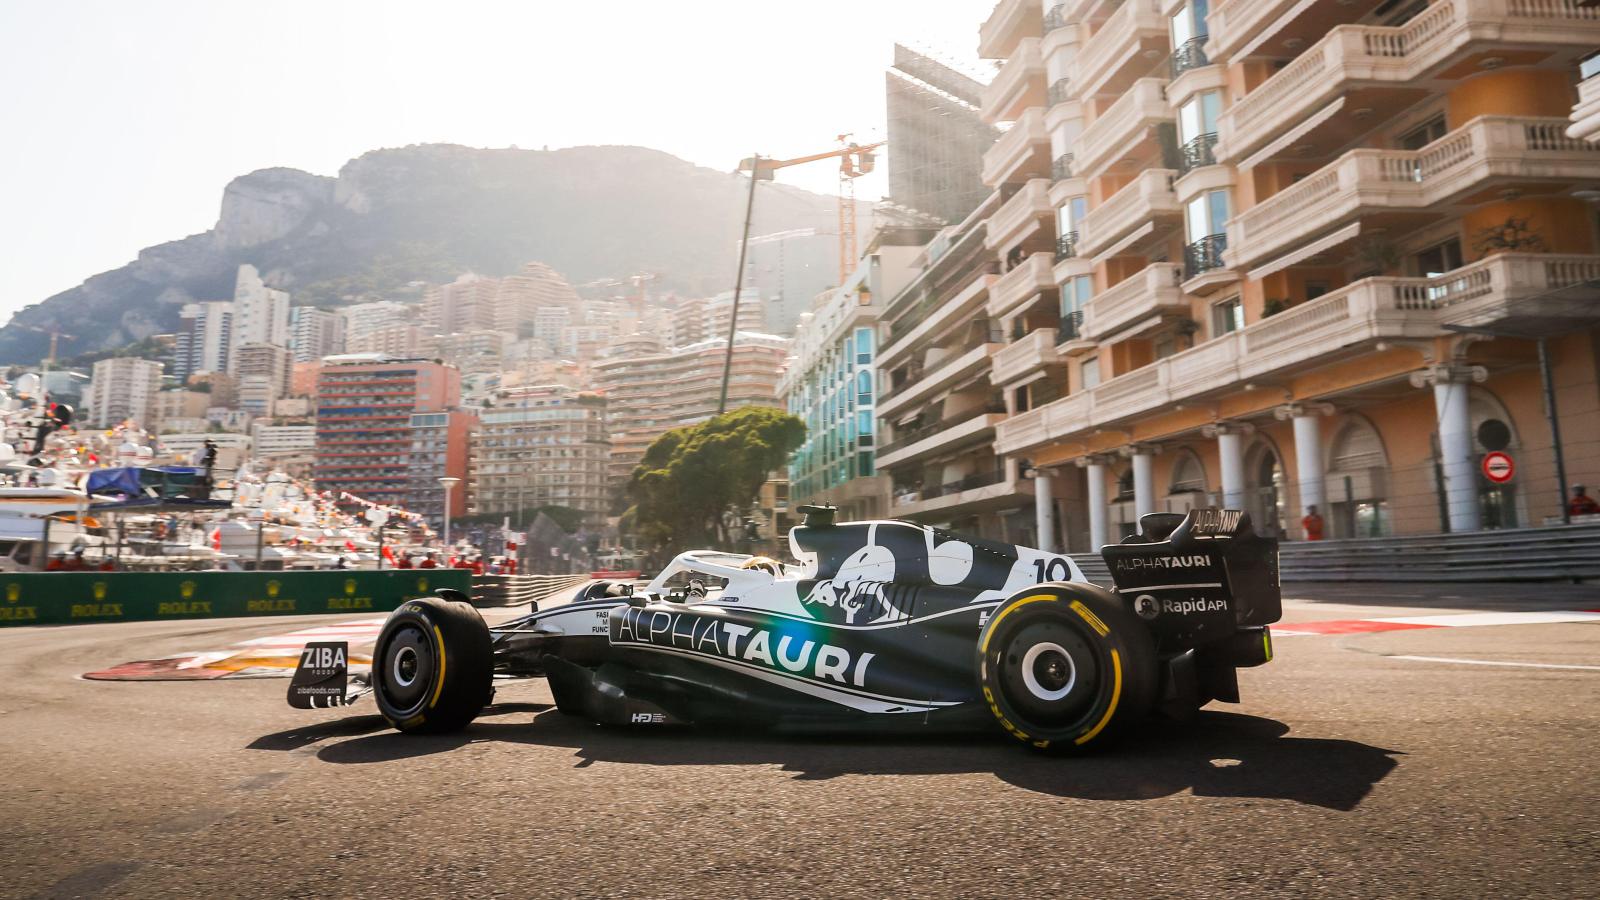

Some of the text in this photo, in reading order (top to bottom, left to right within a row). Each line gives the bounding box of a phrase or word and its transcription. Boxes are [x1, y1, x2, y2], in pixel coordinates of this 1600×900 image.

[1117, 555, 1211, 570] ALPHATAURI
[1033, 557, 1072, 584] 10
[71, 603, 123, 617] ROLEX
[158, 601, 212, 614] ROLEX
[247, 599, 296, 611] ROLEX
[327, 597, 373, 609] ROLEX
[0, 606, 37, 620] OLEX
[619, 608, 876, 687] ALPHATAURI
[302, 647, 346, 668] ZIBA
[297, 686, 341, 695] zibafoods.com
